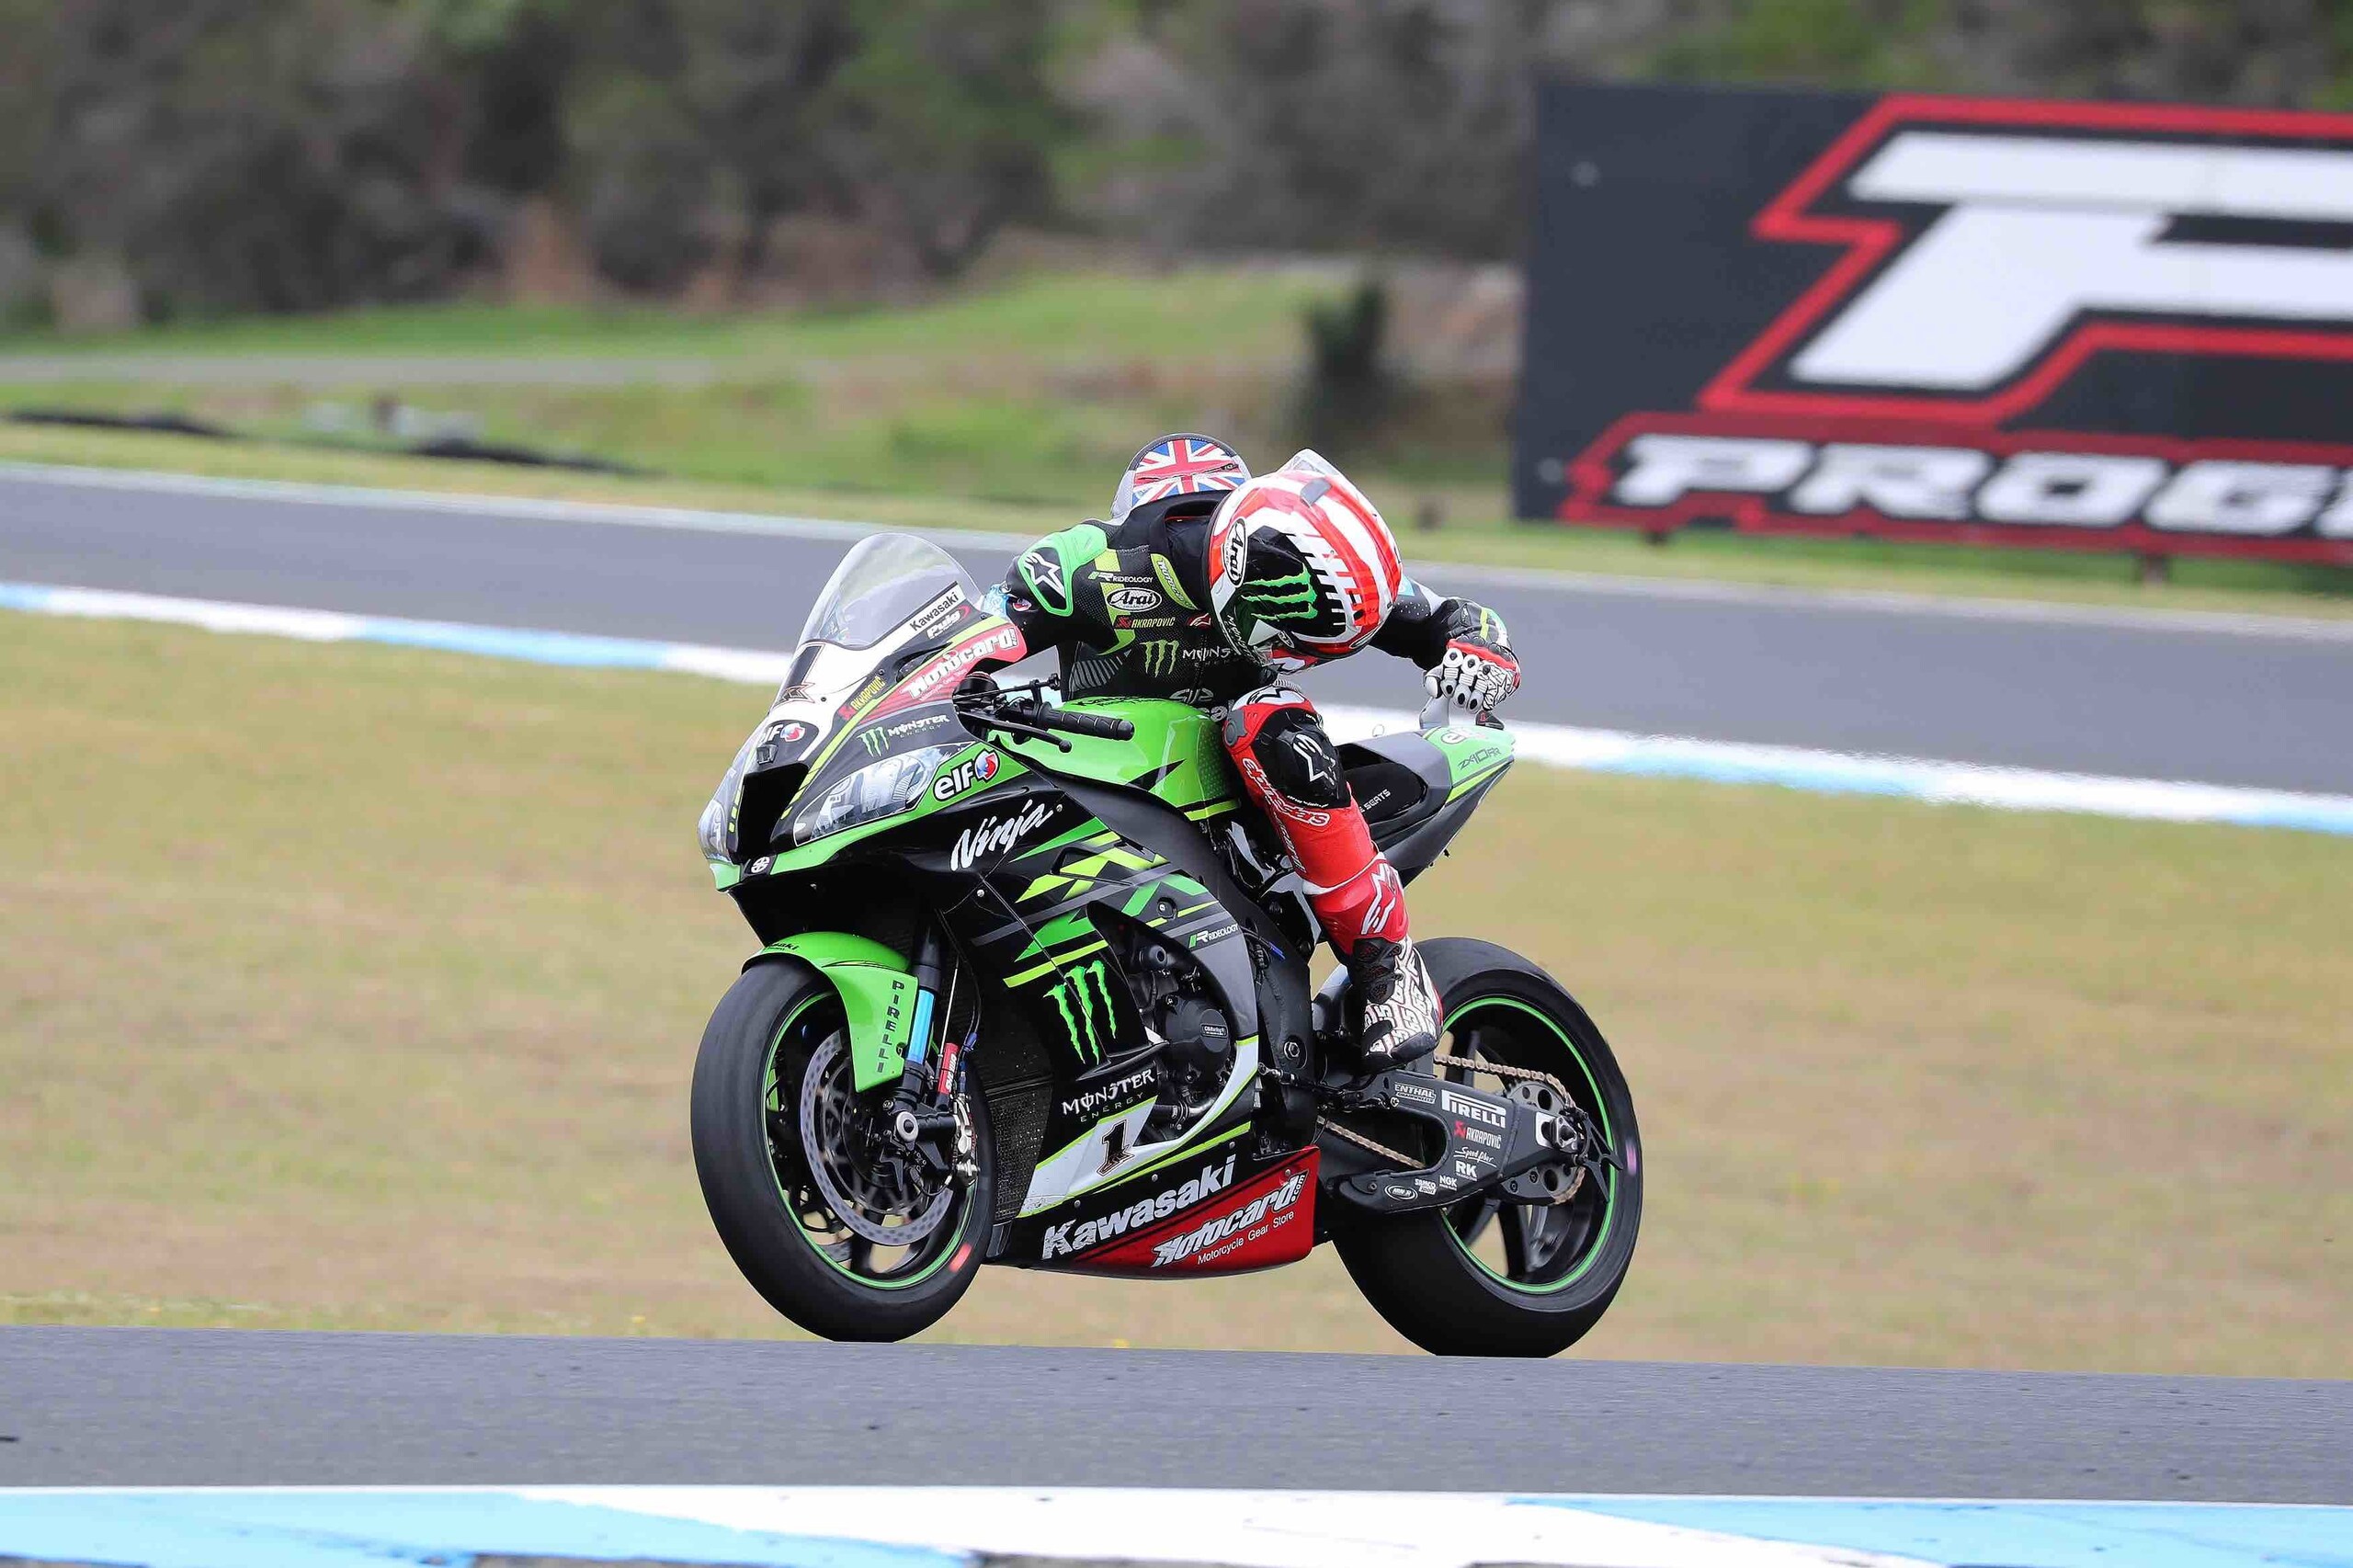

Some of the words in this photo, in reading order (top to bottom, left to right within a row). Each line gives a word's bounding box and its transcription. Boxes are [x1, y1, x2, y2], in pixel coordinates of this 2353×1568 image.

[1615, 434, 2353, 539] PROG
[1229, 522, 1244, 584] Arai
[1109, 591, 1156, 606] Arai
[1112, 575, 1154, 584] RIDEOLOGY
[909, 591, 960, 632] Kawasaki
[1182, 645, 1233, 662] MONS
[887, 714, 950, 737] MONSTER
[933, 761, 974, 801] elf
[1364, 789, 1392, 811] SEATS
[950, 799, 1054, 871] Ninja
[1208, 924, 1239, 941] RIDEOLOGY
[877, 980, 905, 1074] PIRELLI
[1062, 1069, 1155, 1116] MONSTER
[1080, 1091, 1144, 1123] ENERGY
[1394, 1084, 1436, 1098] ENTHAL
[1441, 1089, 1507, 1129] PIRELLI
[1097, 1119, 1135, 1177] 1
[1439, 1175, 1458, 1187] NGK
[1455, 1160, 1478, 1178] RK
[1041, 1153, 1237, 1260] Kawasaki
[1197, 1238, 1245, 1265] Motorcycle
[1247, 1225, 1269, 1242] Gear
[1272, 1210, 1295, 1229] Store
